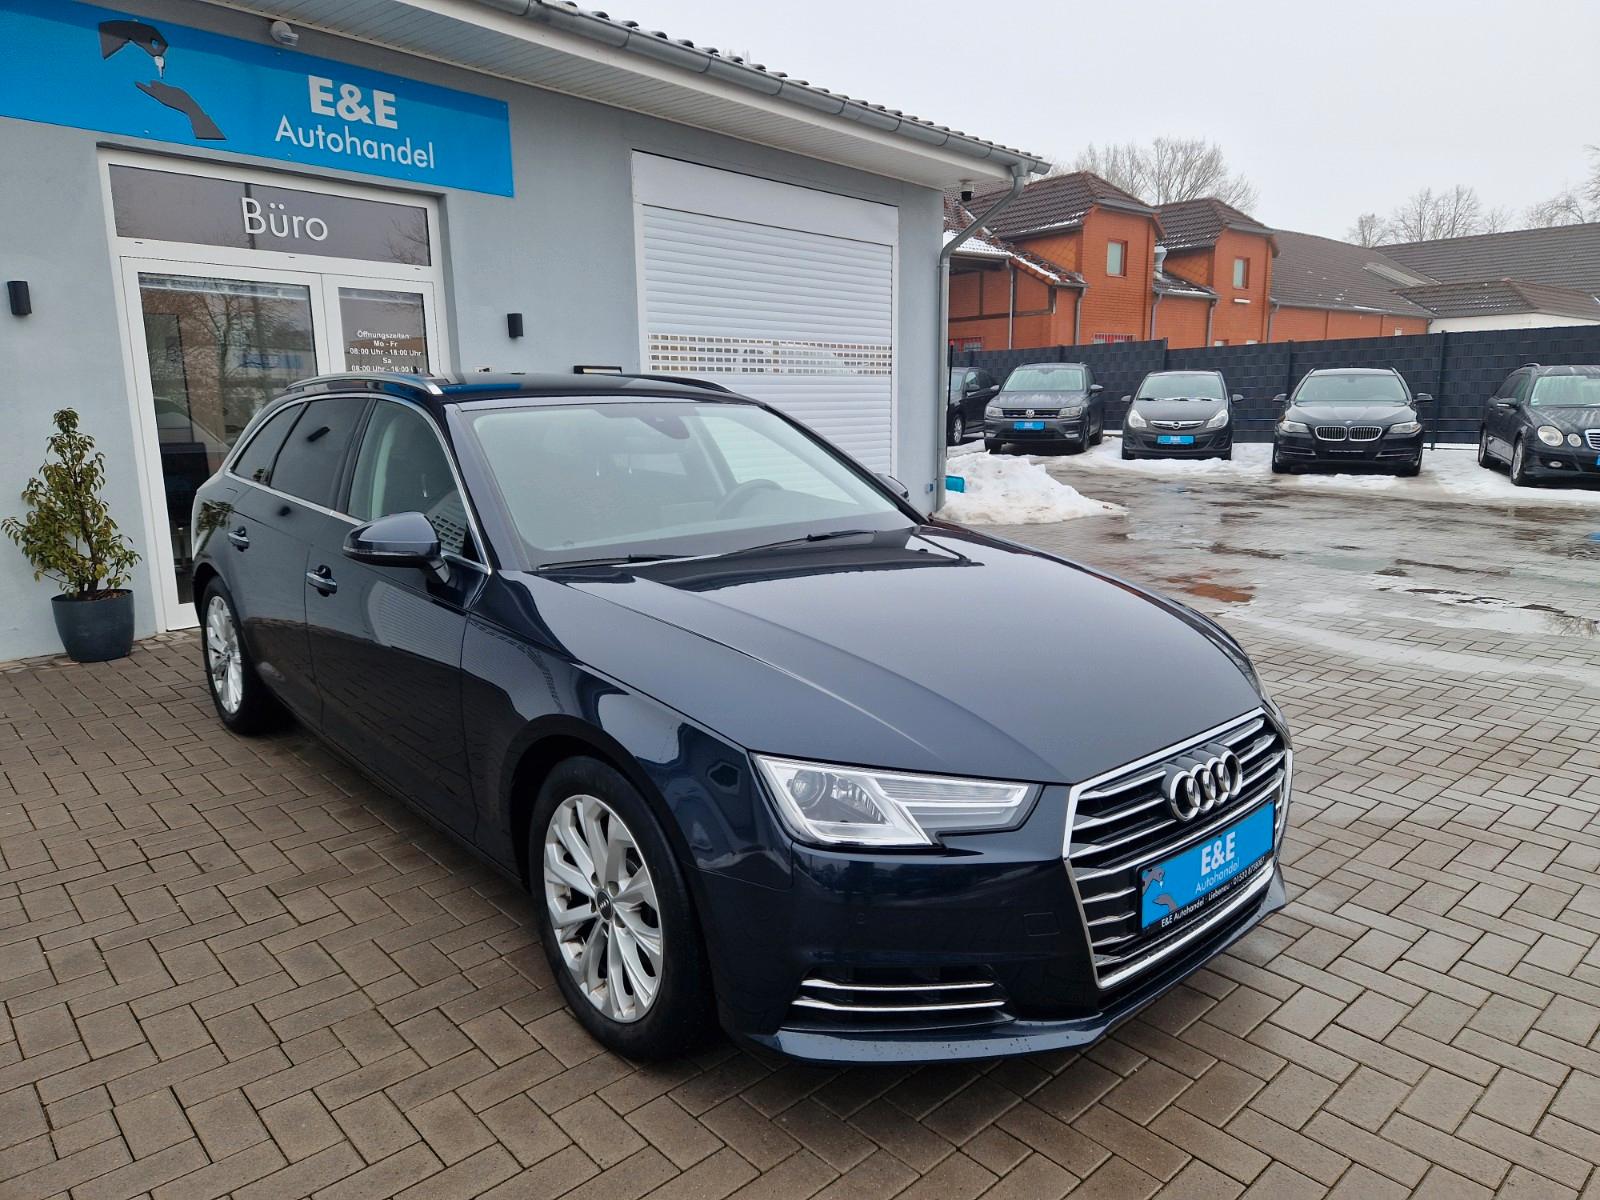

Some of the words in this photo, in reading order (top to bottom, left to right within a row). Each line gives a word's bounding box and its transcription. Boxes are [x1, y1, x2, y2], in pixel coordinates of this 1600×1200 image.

[308, 74, 399, 130] E&E
[274, 114, 435, 169] Autohandel
[241, 197, 328, 241] Büro
[349, 347, 369, 355] 08:00
[1195, 857, 1240, 894] Autohandel
[1201, 832, 1236, 877] E&E
[1161, 915, 1173, 928] E&E
[1173, 897, 1205, 921] Autohandel
